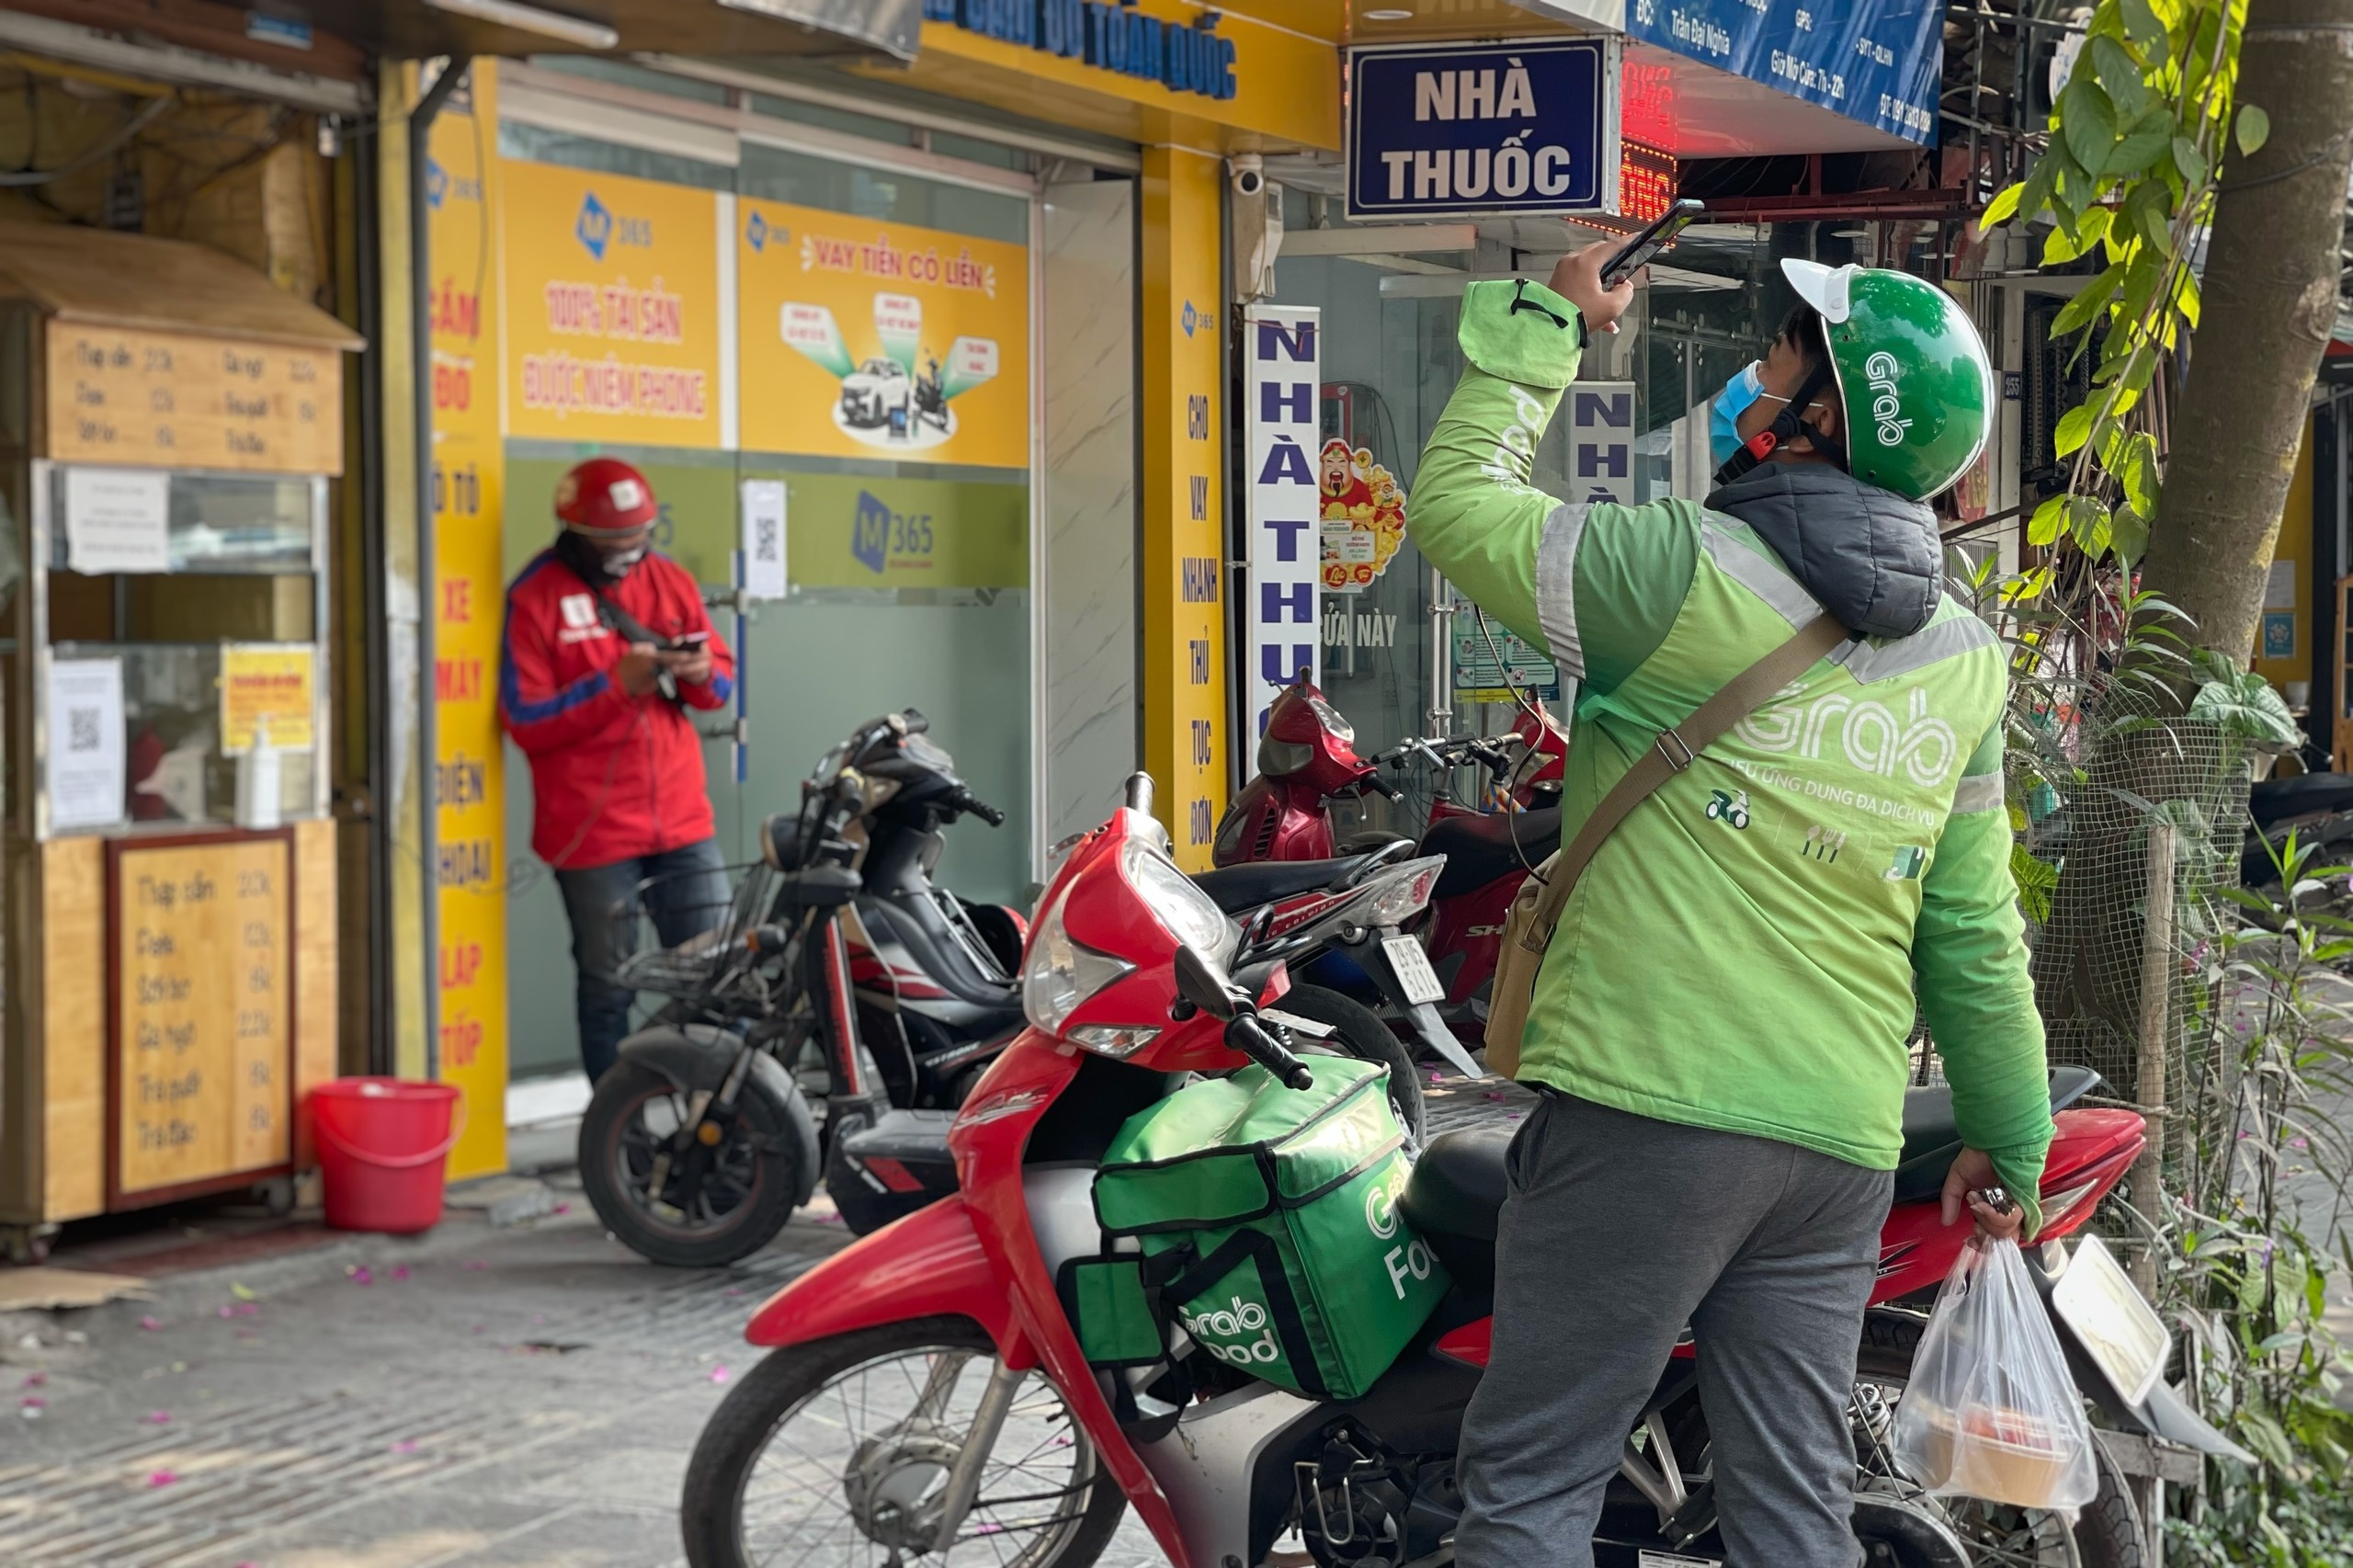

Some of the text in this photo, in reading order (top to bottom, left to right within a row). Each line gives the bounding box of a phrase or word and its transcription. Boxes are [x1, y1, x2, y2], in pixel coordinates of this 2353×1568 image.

[1672, 7, 1730, 57] Trần Đại Nghĩa
[1795, 8, 1812, 32] GPS:
[1170, 11, 1236, 99] QUỐC
[1771, 49, 1786, 75] Giờ
[1786, 54, 1799, 82] Mở
[1799, 59, 1816, 89] Cửa:
[1817, 67, 1826, 93] 7h
[1415, 57, 1537, 121] NHÀ
[1381, 129, 1571, 199] THUỐC
[813, 238, 856, 270] VAY
[907, 245, 939, 283] CÓ
[544, 279, 602, 335] 100%
[1257, 319, 1316, 485] NHÀ
[1865, 351, 1914, 447] Grab
[2006, 377, 2019, 395] 255
[1188, 394, 1209, 441] CHO
[1190, 475, 1209, 521] VAY
[443, 578, 472, 623] XE
[1182, 557, 1218, 603] NHANH
[1320, 601, 1397, 647] ỬA NÀY
[1189, 625, 1210, 685] THỦ
[1191, 720, 1211, 774] TỤC
[1733, 681, 1957, 788] Grab
[1190, 795, 1212, 846] ĐƠN
[1804, 780, 1853, 805] DỤNG
[1857, 793, 1877, 812] ĐA
[1918, 809, 1935, 830] VỤ
